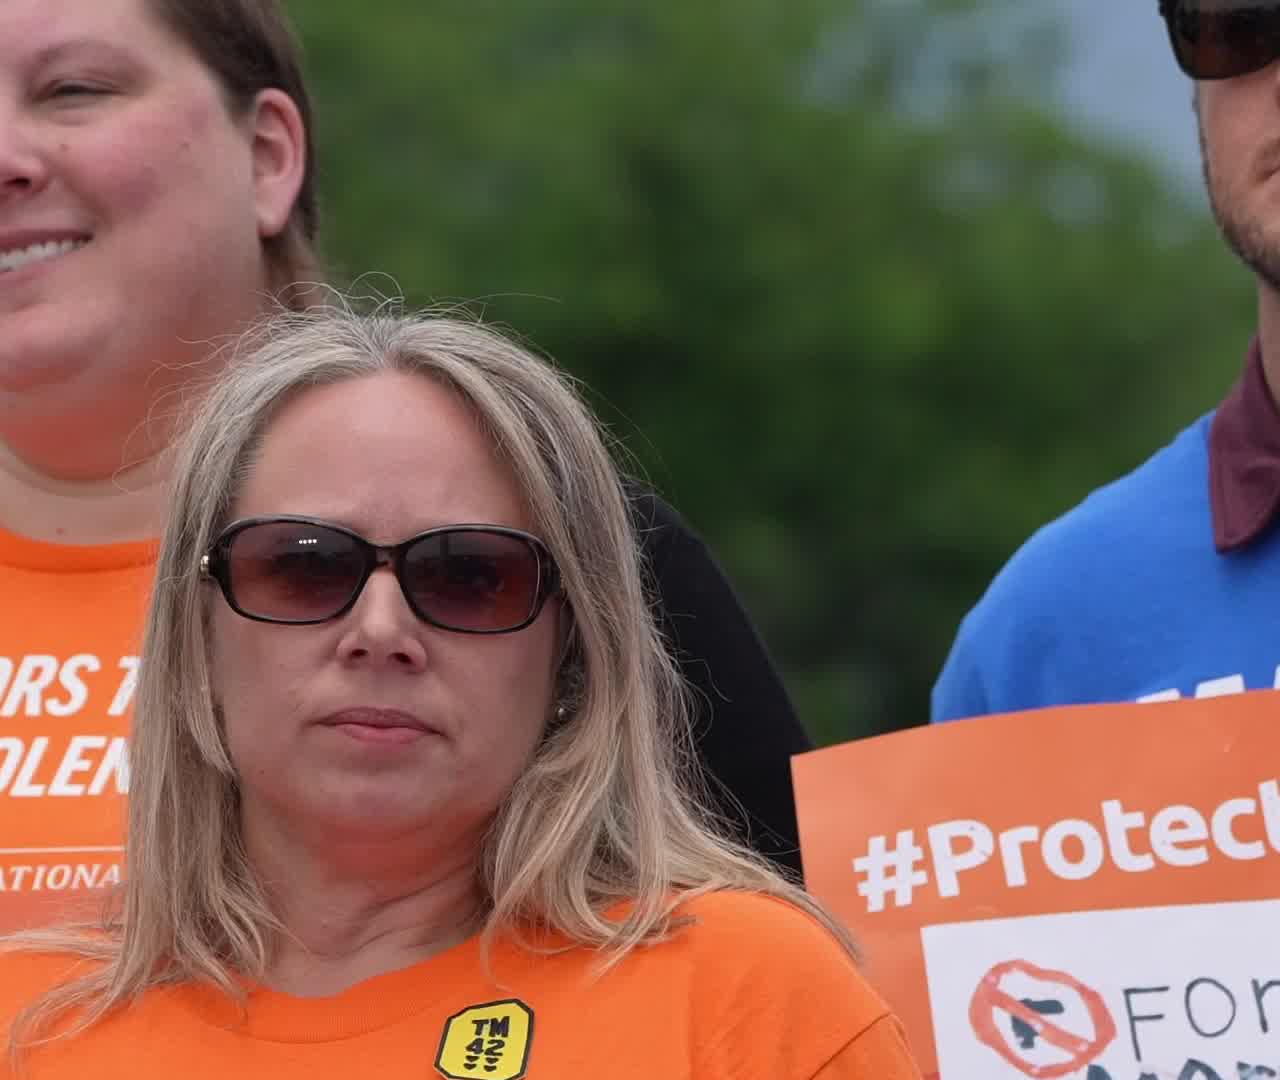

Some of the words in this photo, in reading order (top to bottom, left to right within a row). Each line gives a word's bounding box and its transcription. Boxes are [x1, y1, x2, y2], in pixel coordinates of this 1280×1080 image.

[107, 655, 141, 716] T
[472, 1016, 510, 1037] TM
[465, 1038, 505, 1056] 42
